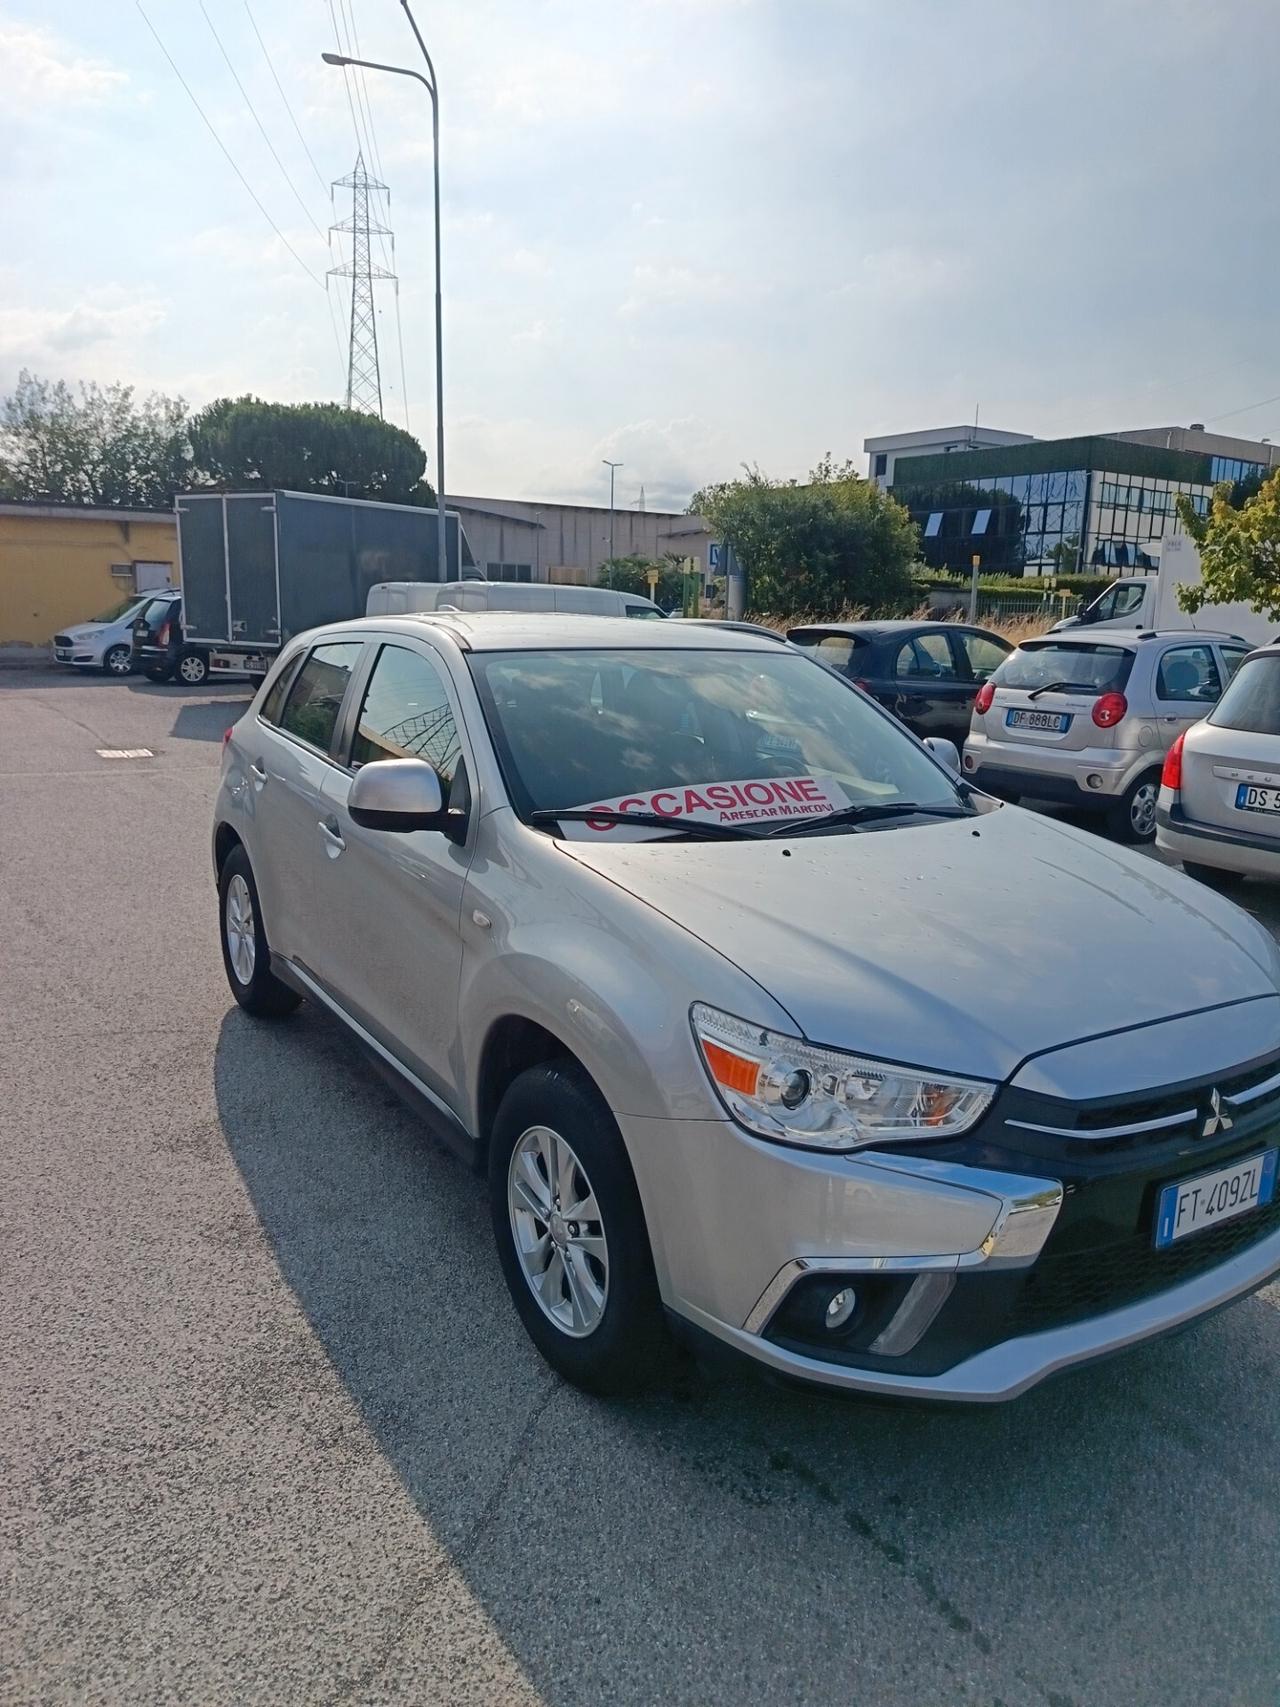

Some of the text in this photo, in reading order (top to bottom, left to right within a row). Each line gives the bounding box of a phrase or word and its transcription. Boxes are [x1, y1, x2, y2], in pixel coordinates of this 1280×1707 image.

[1248, 788, 1268, 806] DS
[720, 803, 835, 822] ARESCAR MARCONI
[1176, 1168, 1258, 1228] FT 409ZL
